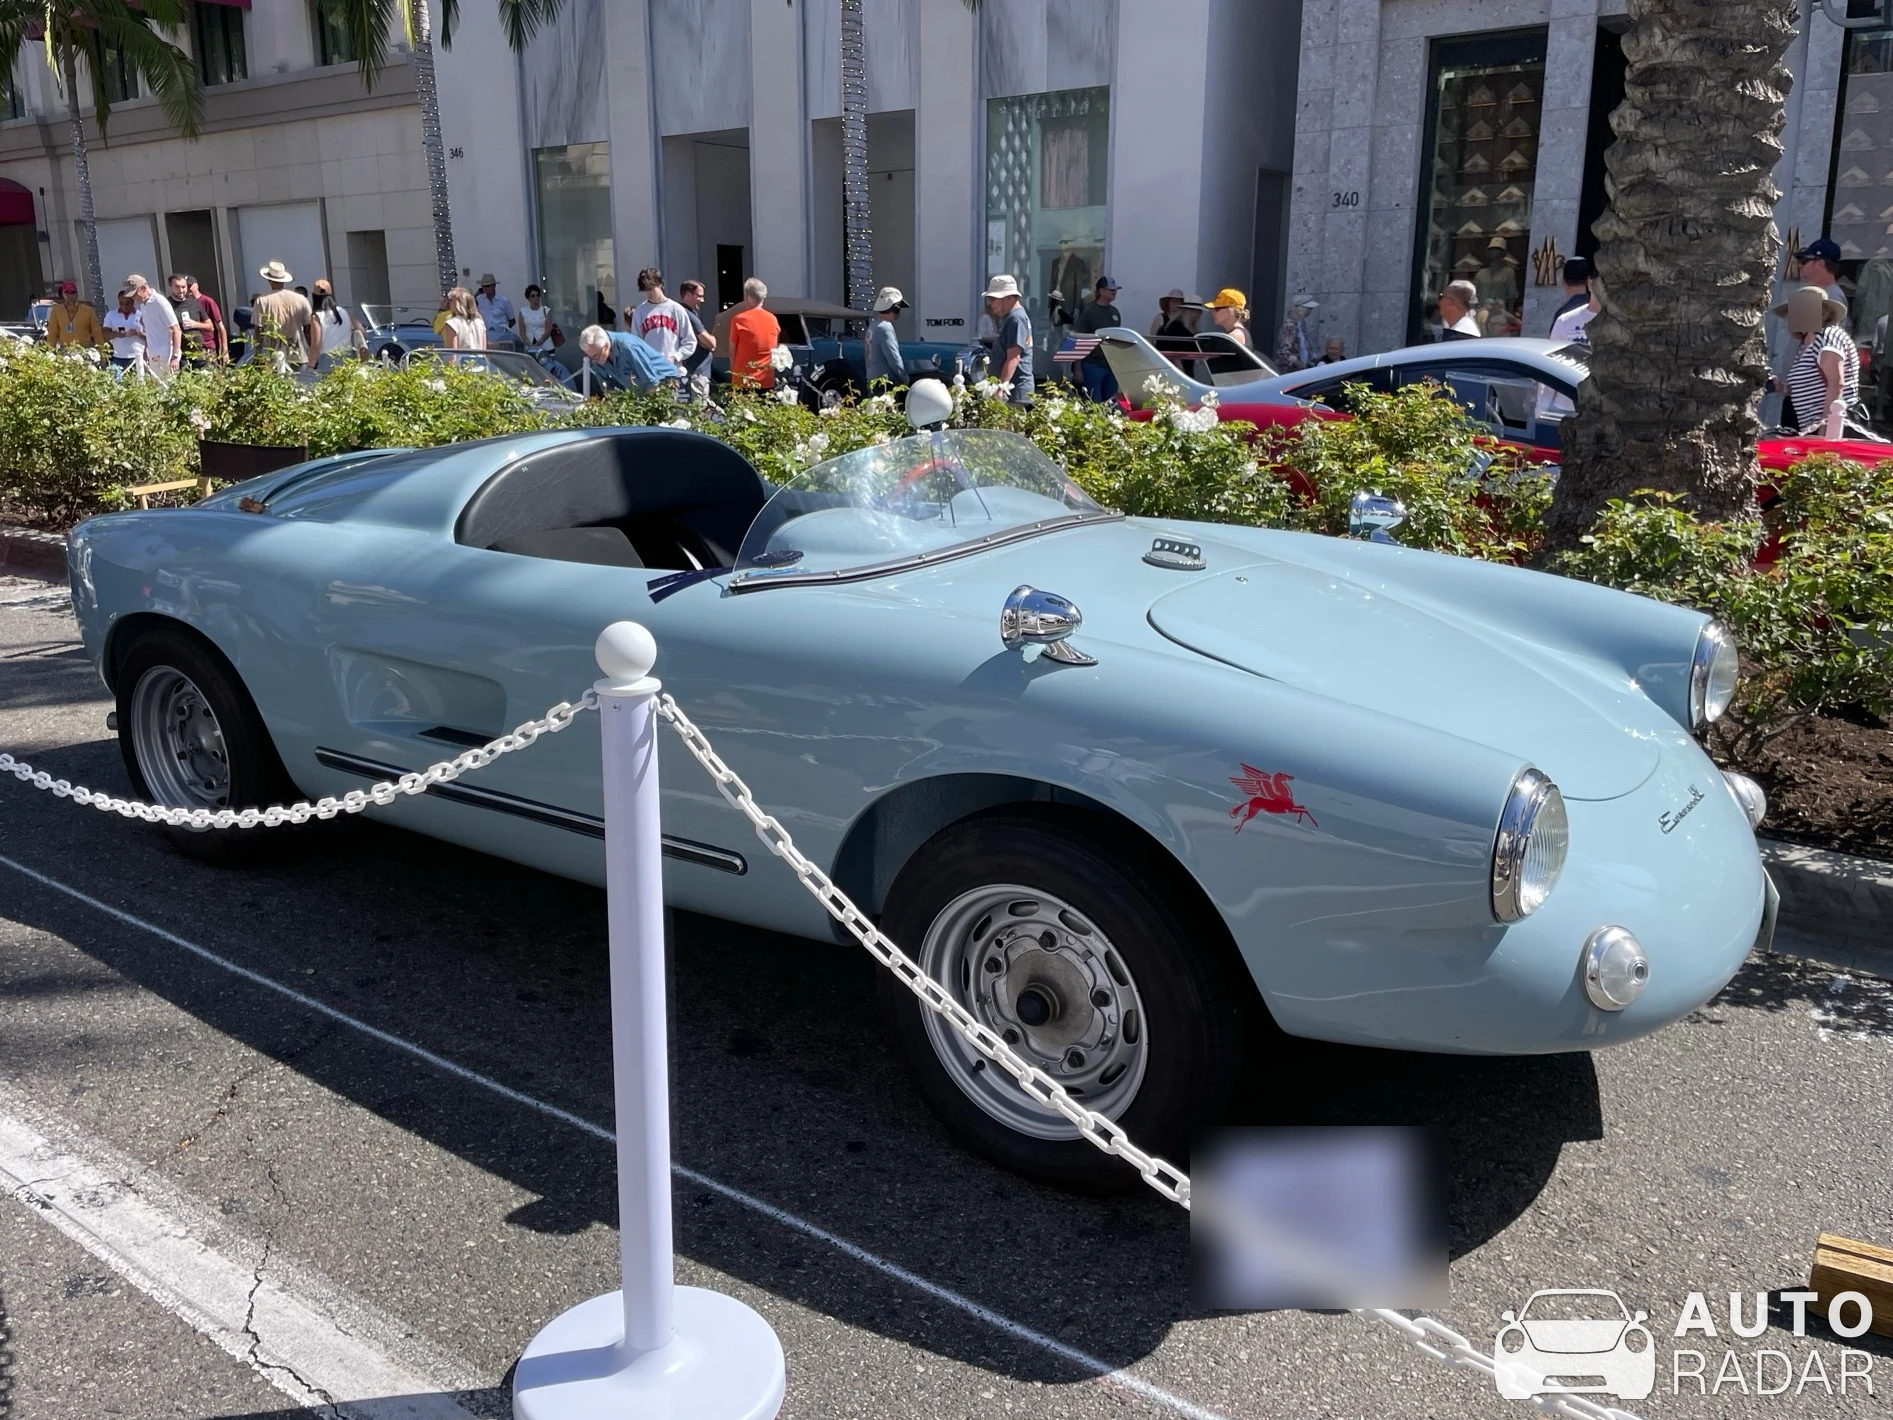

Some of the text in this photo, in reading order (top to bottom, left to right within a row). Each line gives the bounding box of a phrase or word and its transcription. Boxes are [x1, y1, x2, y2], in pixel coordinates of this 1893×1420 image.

[449, 146, 464, 160] 346
[1332, 191, 1359, 208] 340
[925, 318, 965, 327] TOM FORD
